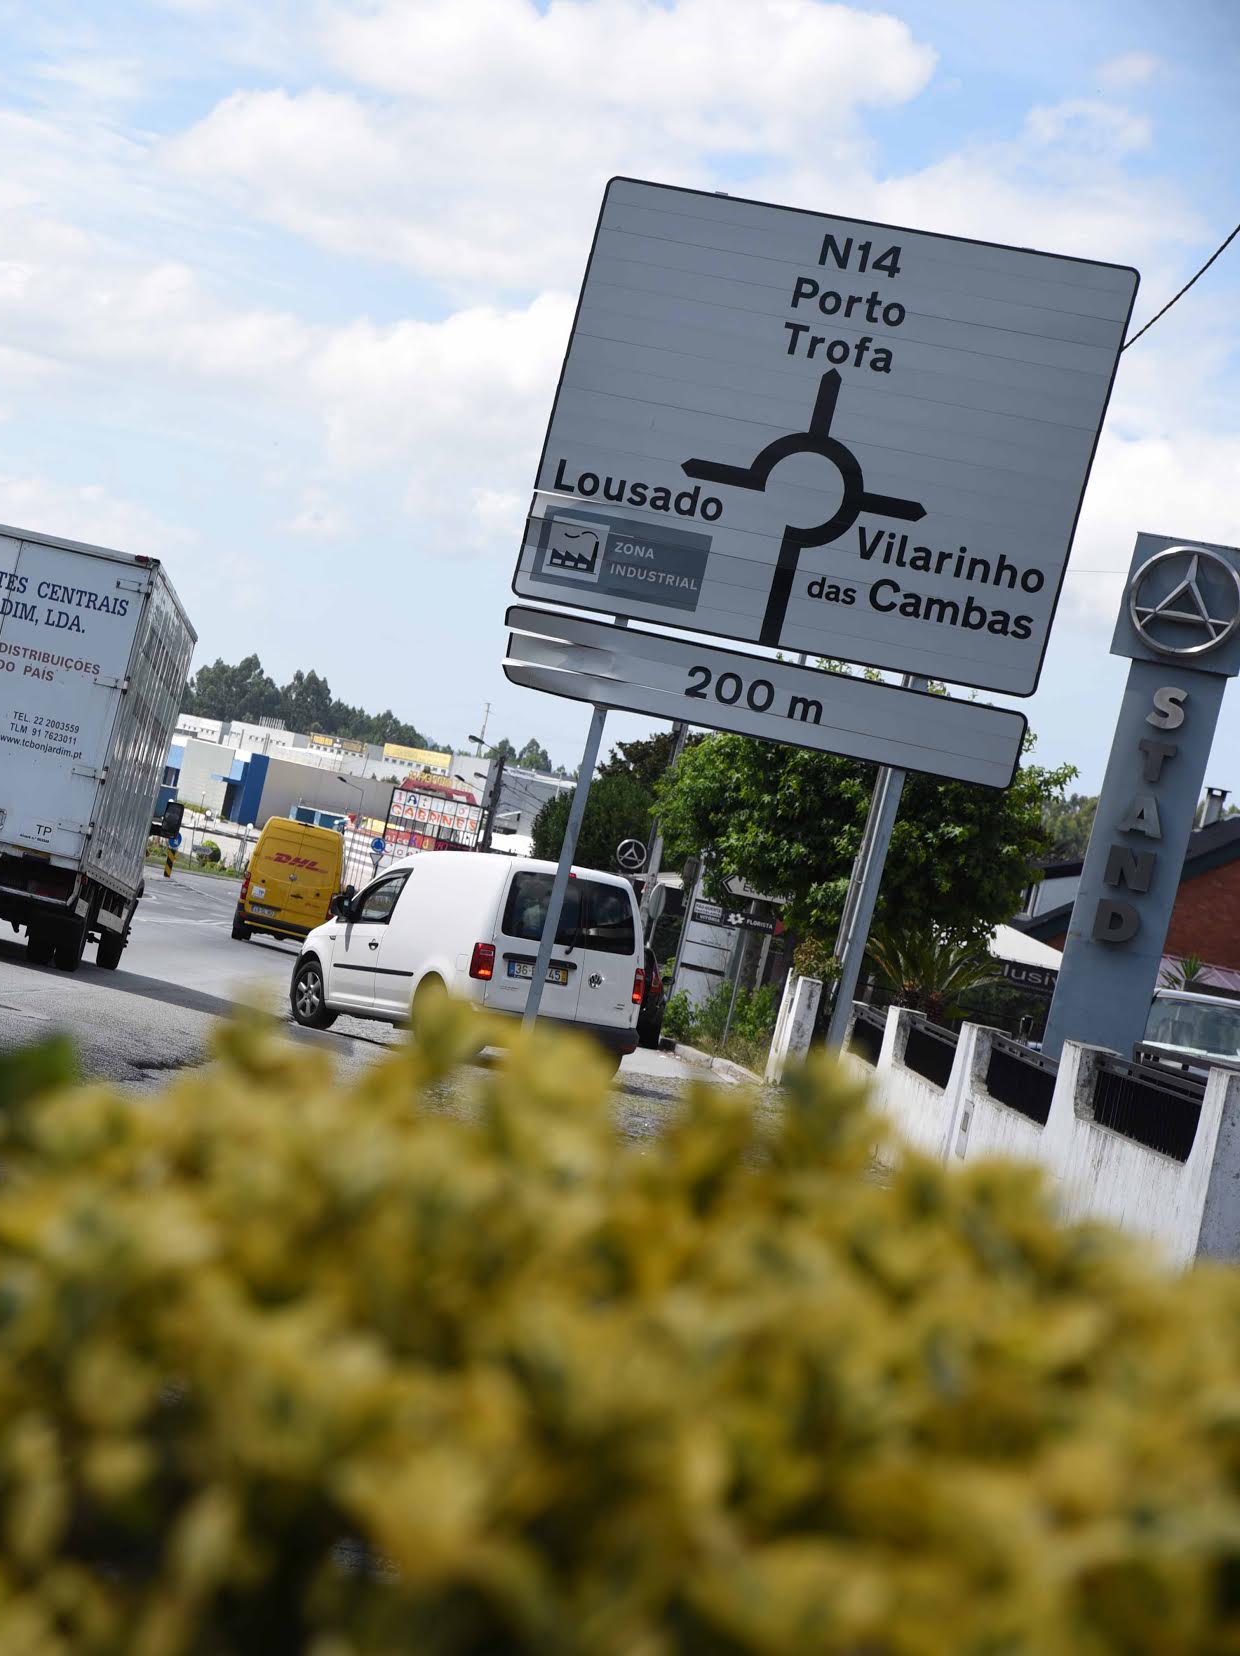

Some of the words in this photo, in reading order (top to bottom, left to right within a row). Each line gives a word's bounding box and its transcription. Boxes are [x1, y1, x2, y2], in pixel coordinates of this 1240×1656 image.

[818, 233, 902, 279] N14
[791, 276, 906, 327] Porto
[784, 321, 893, 374] Trofa
[554, 458, 723, 521] Lousado
[614, 541, 654, 559] ZONA
[858, 526, 1045, 593] Vilarinho
[610, 563, 698, 591] INDUSTRIAL
[37, 581, 129, 617] CENTRAIS
[807, 577, 857, 605] das
[869, 578, 1034, 640] Cambas
[44, 609, 86, 633] LDA.
[23, 665, 54, 682] PAÍS
[684, 665, 775, 712] 200
[787, 695, 823, 724] m
[10, 722, 28, 734] TLM
[31, 727, 41, 737] 91
[44, 730, 77, 745] 7623011
[13, 710, 31, 723] TEL.
[33, 715, 44, 725] 22
[45, 718, 80, 734] 2003559
[0, 734, 83, 760] www.tcbonjardim.pt
[1091, 686, 1189, 943] STAND
[36, 824, 52, 836] TP
[273, 852, 320, 872] DHL
[746, 919, 773, 929] FLORISTA
